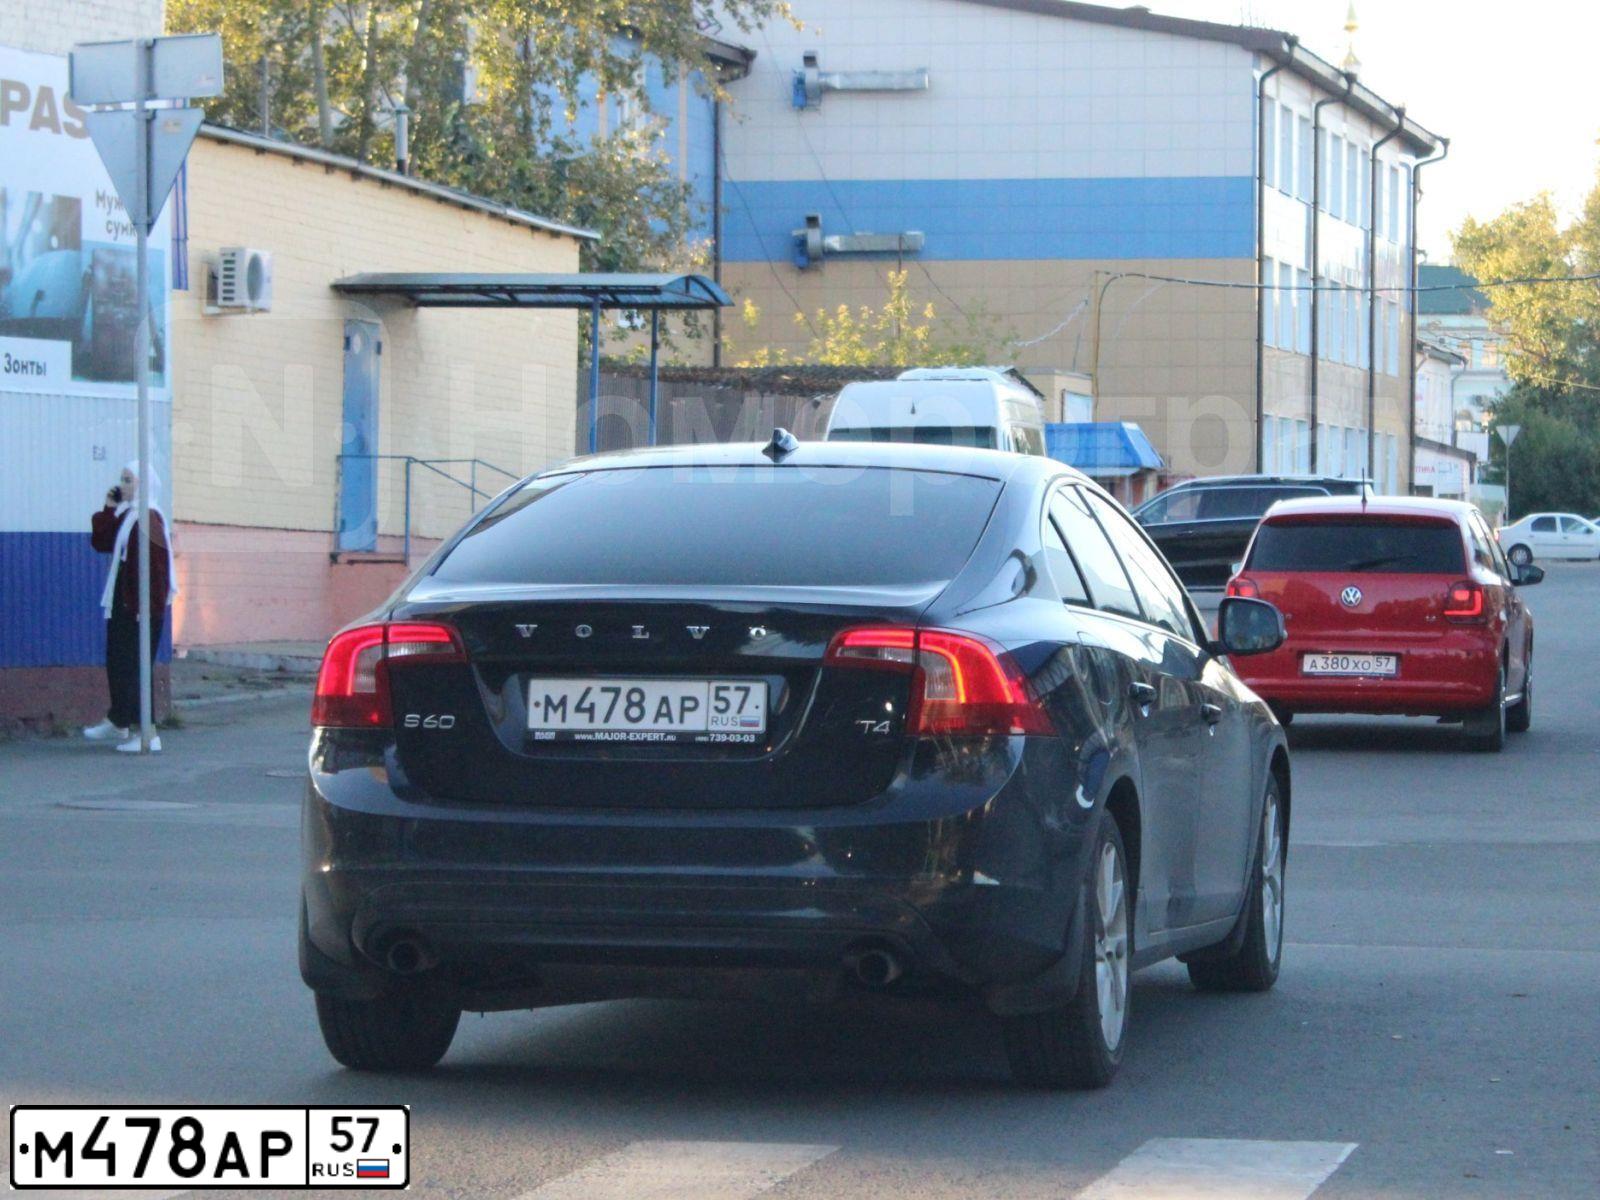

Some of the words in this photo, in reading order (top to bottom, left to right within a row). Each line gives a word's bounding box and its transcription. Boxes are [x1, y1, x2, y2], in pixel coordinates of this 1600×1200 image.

[0, 79, 122, 139] PAS
[4, 352, 47, 376] Зонты
[515, 623, 767, 640] VOLVO
[1309, 656, 1371, 670] А380ХО
[1375, 656, 1391, 668] 57
[543, 686, 700, 725] М478АР
[713, 685, 752, 714] 57
[403, 713, 456, 730] S60
[710, 715, 739, 728] RUS
[857, 720, 891, 735] T4
[709, 733, 756, 743] 739-03-03
